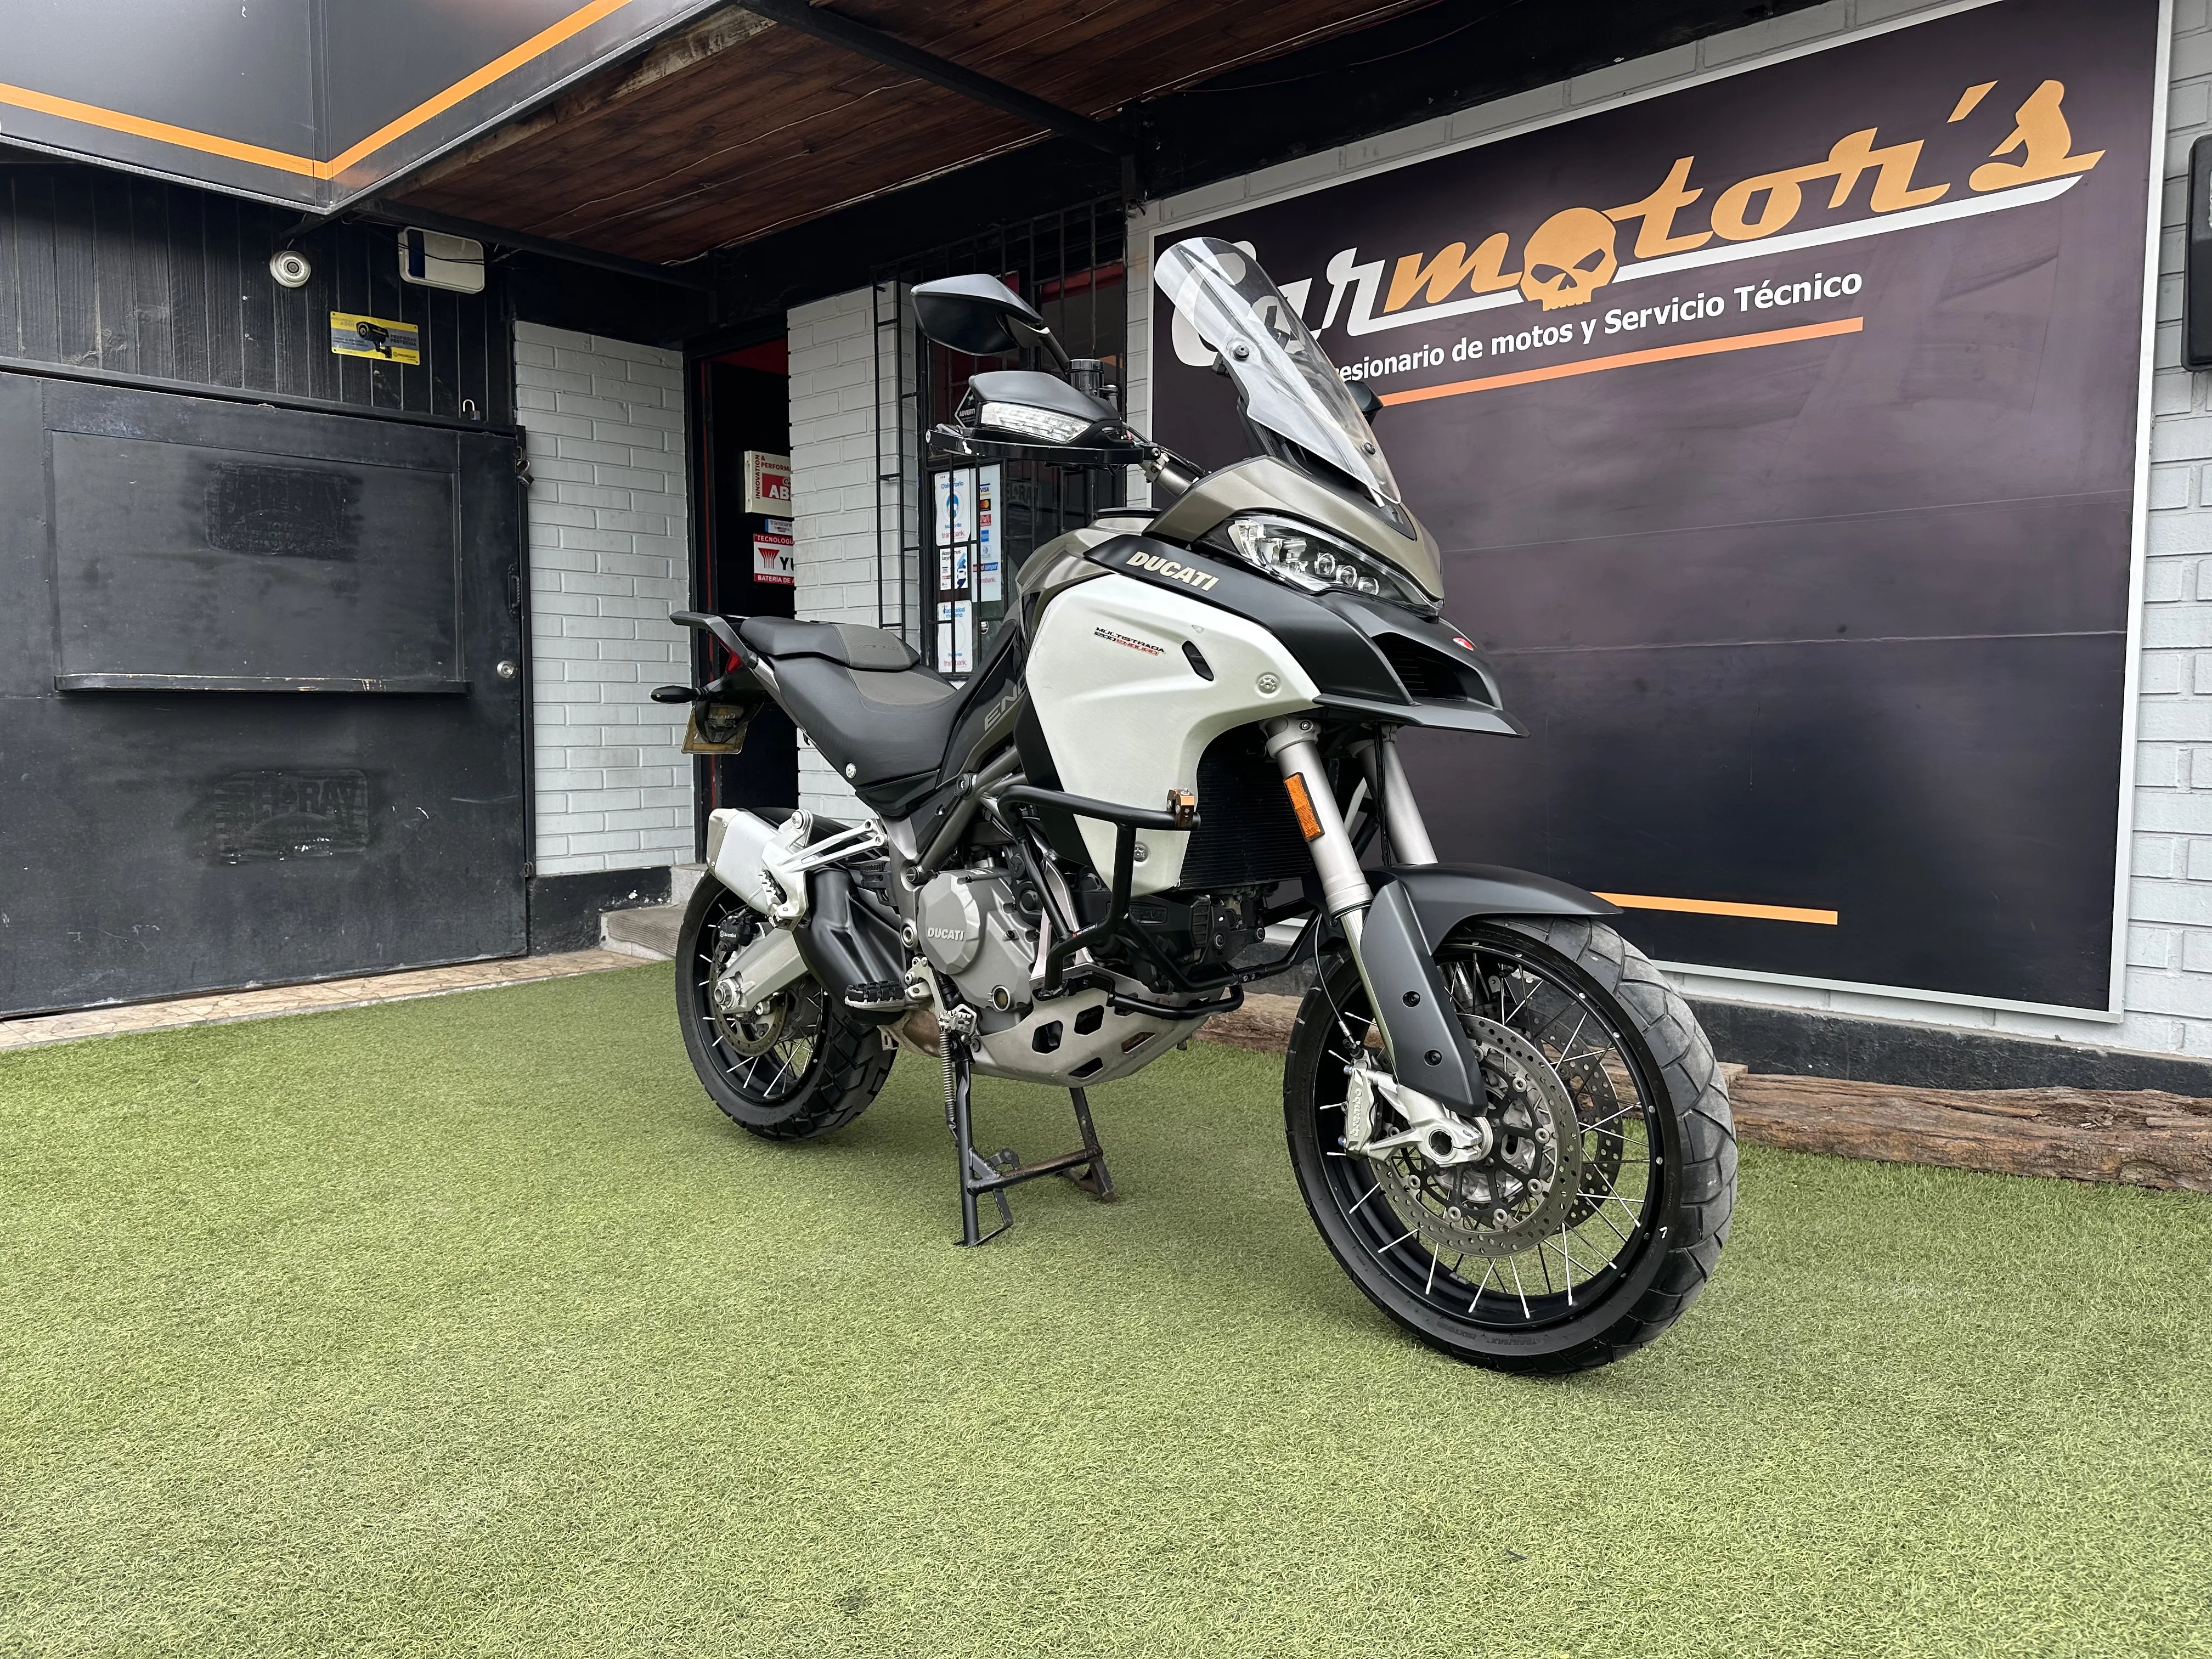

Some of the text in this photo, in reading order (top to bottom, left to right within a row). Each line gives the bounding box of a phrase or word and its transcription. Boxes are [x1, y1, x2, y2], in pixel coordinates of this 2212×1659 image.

[1452, 337, 1483, 362] de
[1491, 325, 1573, 356] motos
[1581, 318, 1597, 345] y
[1604, 293, 1725, 334] Servicio
[1734, 273, 1863, 312] Técnico
[1126, 551, 1220, 591] DUCATI
[1096, 627, 1165, 653] MULTISTRADA
[927, 927, 965, 941] DUCATI
